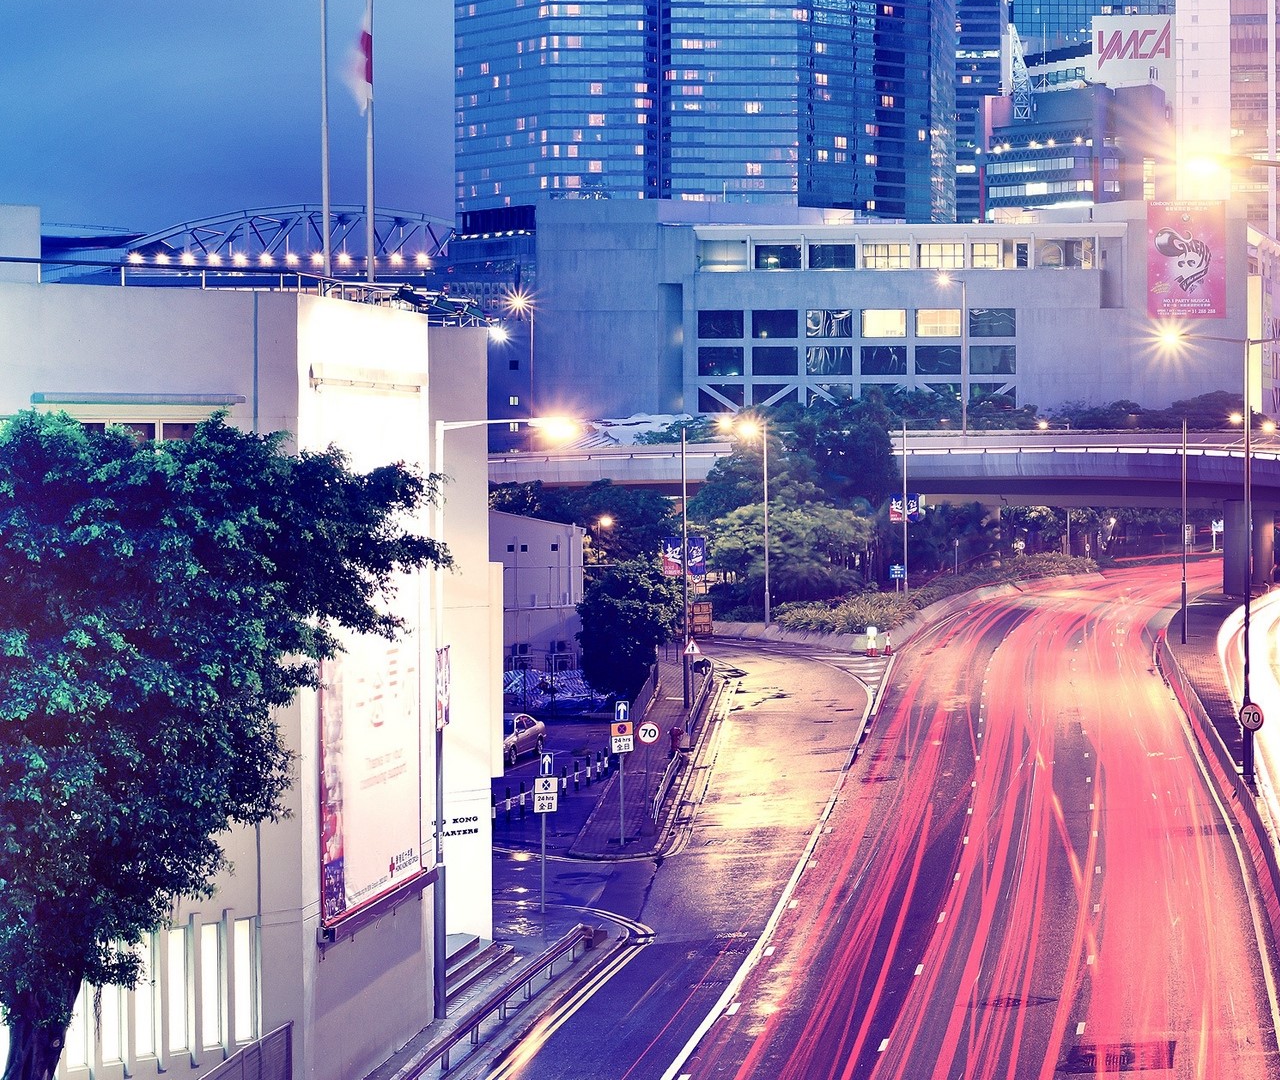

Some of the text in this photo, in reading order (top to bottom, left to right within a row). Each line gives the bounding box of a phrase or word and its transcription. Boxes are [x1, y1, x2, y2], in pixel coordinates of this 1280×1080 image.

[1098, 19, 1171, 70] YMCA
[1244, 711, 1260, 723] 70
[641, 728, 657, 738] 70
[539, 802, 553, 810] 全日
